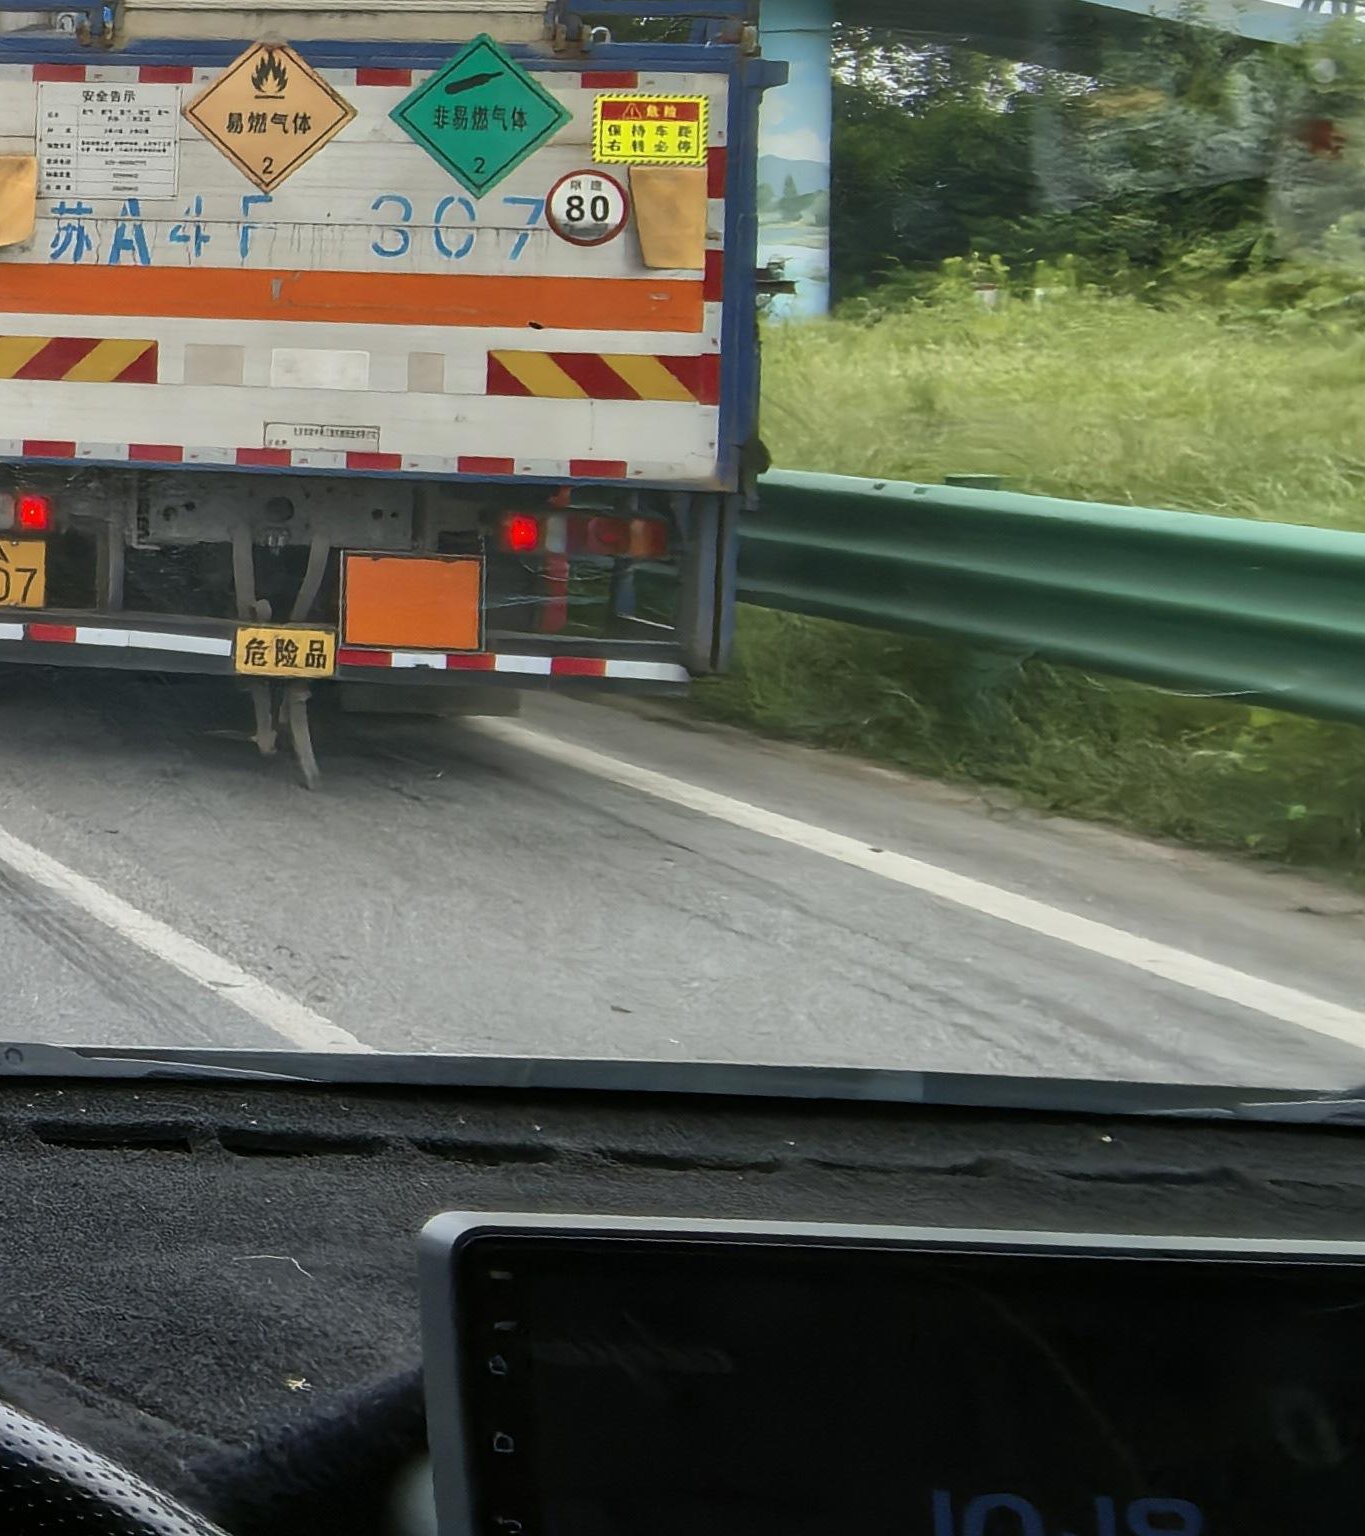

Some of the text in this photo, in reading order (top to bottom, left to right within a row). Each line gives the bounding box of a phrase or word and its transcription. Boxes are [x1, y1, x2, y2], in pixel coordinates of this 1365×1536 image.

[226, 111, 312, 135] 易燃气体
[433, 104, 528, 133] 非易燃气体
[261, 157, 274, 175] 2
[473, 157, 486, 175] 2
[565, 195, 610, 223] 80
[243, 637, 327, 670] 危险品
